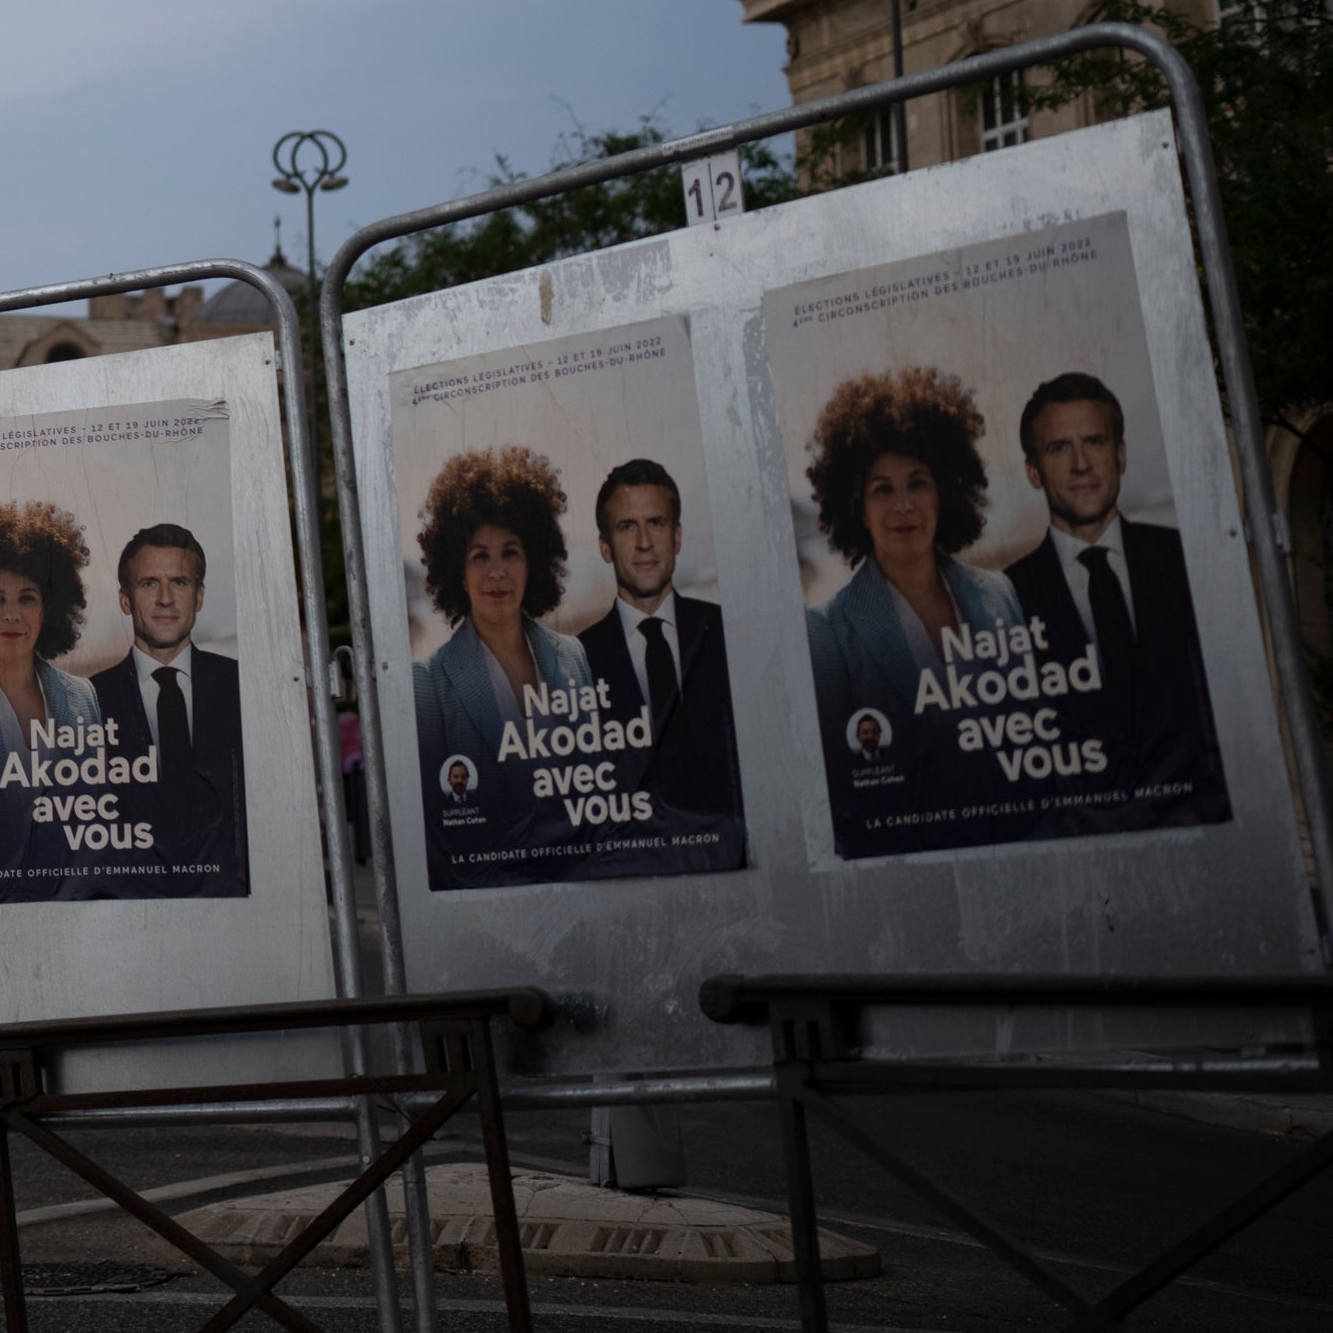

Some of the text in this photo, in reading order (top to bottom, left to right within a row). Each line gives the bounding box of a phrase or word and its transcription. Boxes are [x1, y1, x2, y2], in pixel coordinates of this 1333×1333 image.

[2, 426, 76, 440] LÉGISLATIVES
[91, 423, 102, 431] 12
[108, 422, 119, 430] ET
[125, 420, 137, 428] 19
[143, 418, 168, 428] JUIN
[62, 436, 82, 445] DES
[87, 426, 204, 443] BOUCHES-DU-RHÔNE
[940, 617, 1049, 666] Najat
[914, 644, 1101, 714] Akodad
[522, 678, 611, 722] Najat
[29, 716, 119, 756] Najat
[497, 705, 651, 762] Akodad
[958, 708, 1061, 751] avec
[995, 739, 1107, 781] vous
[533, 761, 617, 797] avec
[33, 793, 119, 823] avec
[562, 790, 653, 826] vous
[62, 822, 154, 850] vous
[452, 833, 719, 864] LA CANDIDATE OFFICIELLE D'EMMANUEL MACRON
[27, 867, 89, 877] OFFICIELLE
[95, 865, 167, 875] D'EMMANUEL
[172, 864, 220, 872] MACRON
